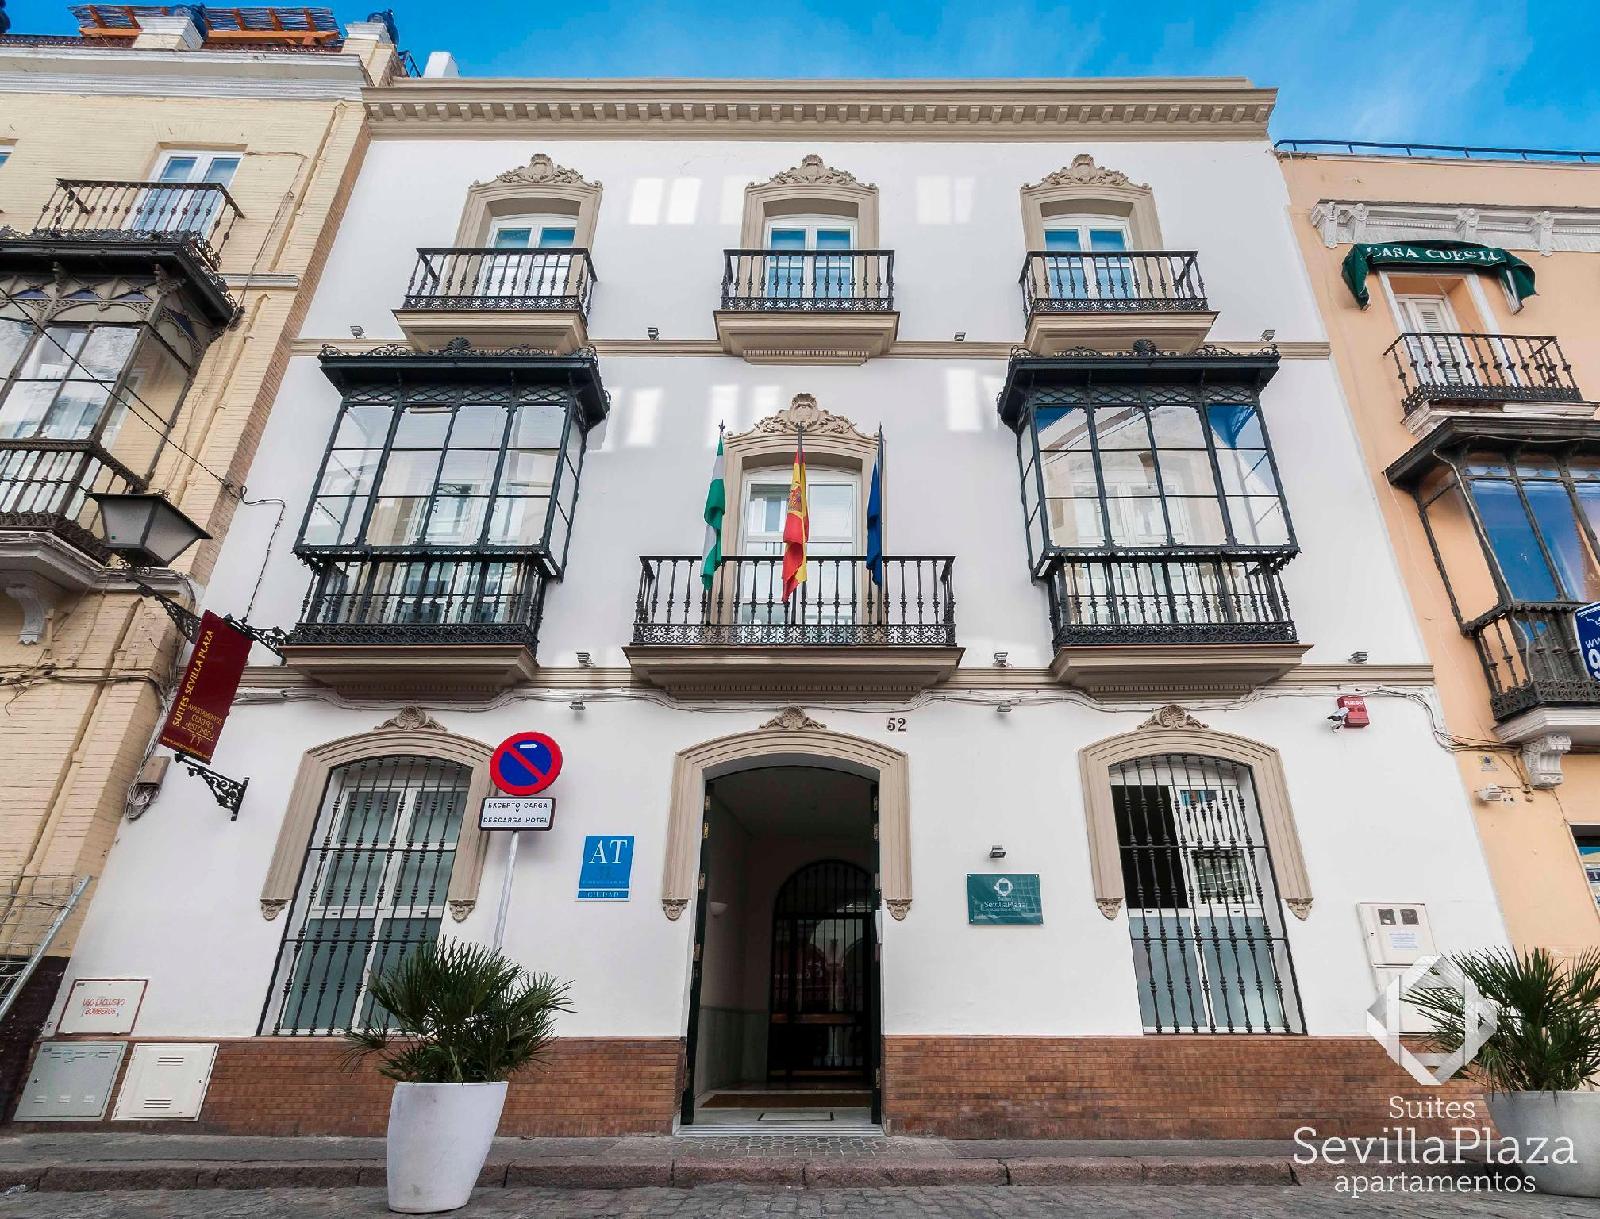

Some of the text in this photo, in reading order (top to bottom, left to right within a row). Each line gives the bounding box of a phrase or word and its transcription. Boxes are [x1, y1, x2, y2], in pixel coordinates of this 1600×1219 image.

[172, 630, 215, 727] SUITES SEVILLA PLAZA
[887, 717, 907, 732] 52
[588, 839, 628, 864] AT
